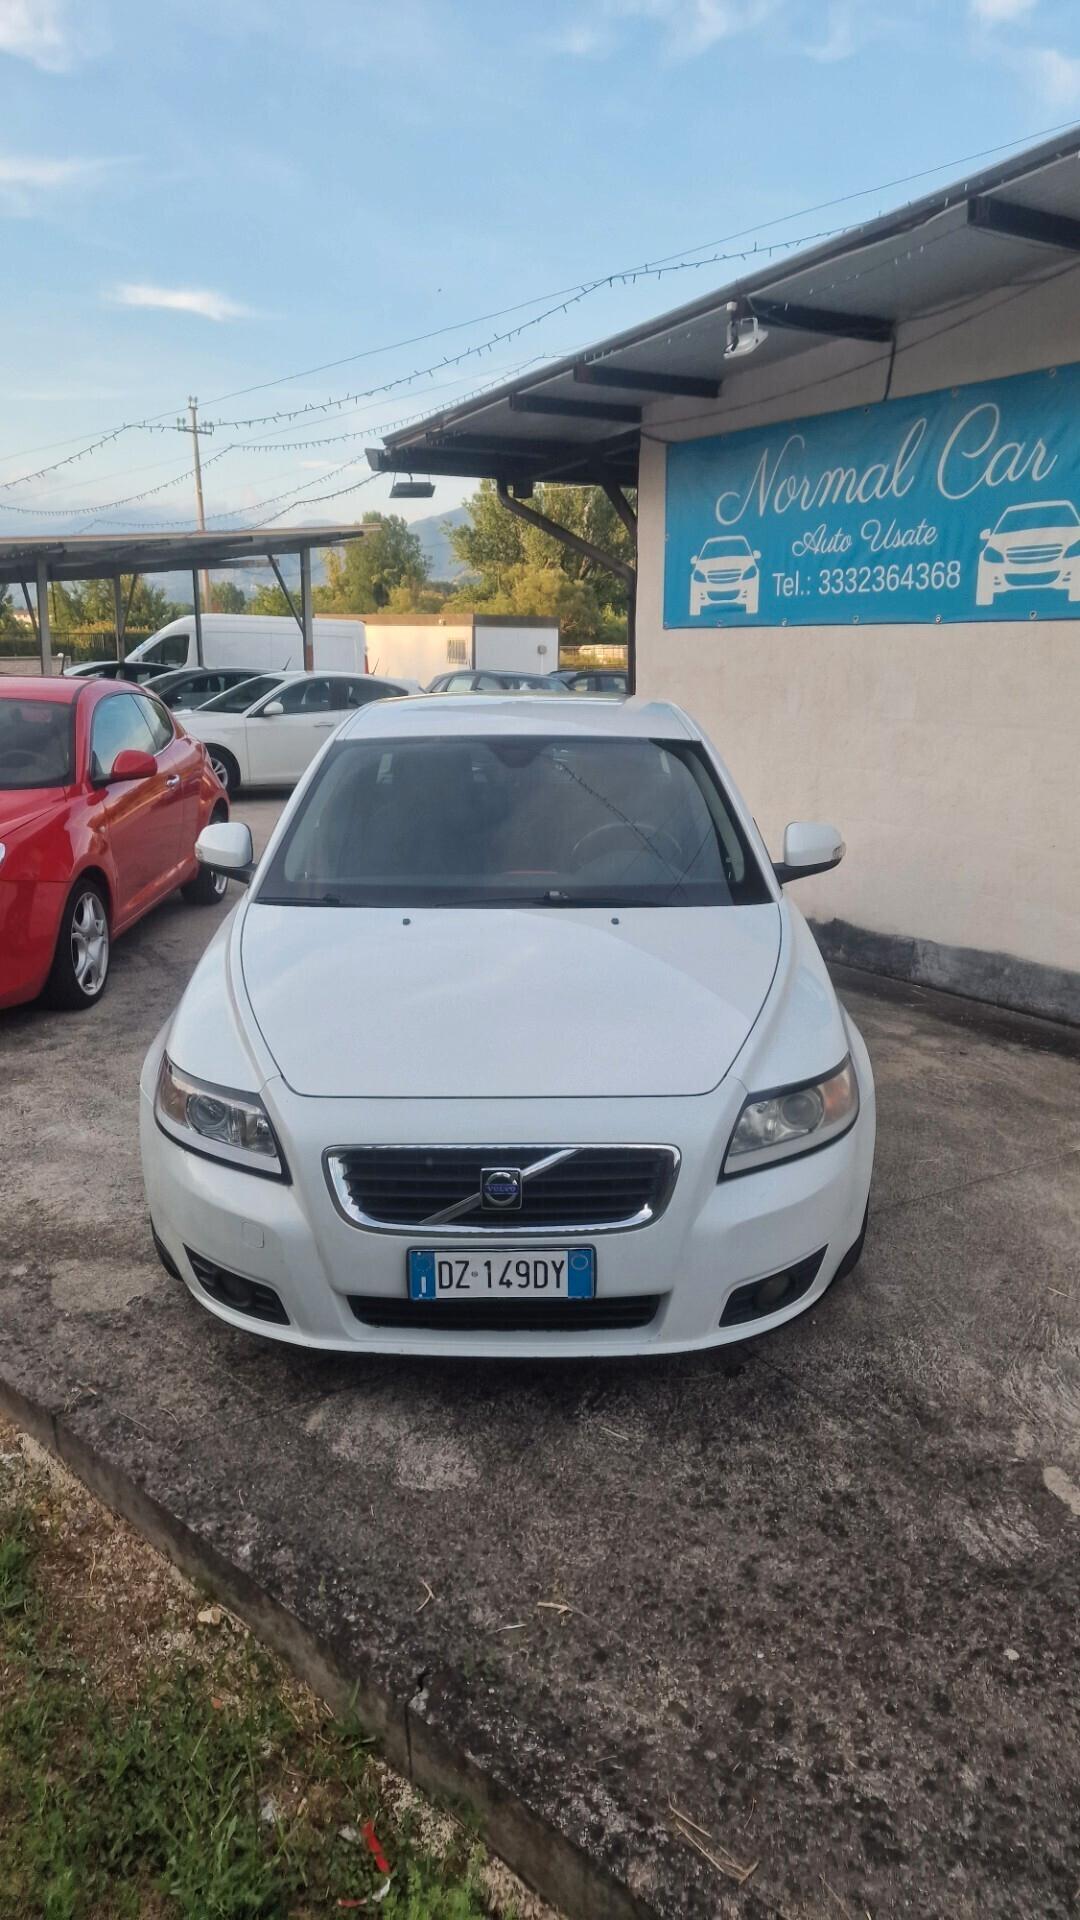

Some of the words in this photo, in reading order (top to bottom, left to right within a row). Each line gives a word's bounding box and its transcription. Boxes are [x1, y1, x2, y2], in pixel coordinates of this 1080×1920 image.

[715, 418, 927, 525] Normal
[936, 403, 1058, 500] Car
[792, 523, 852, 557] Auto
[861, 518, 938, 552] Usate
[772, 572, 811, 597] Tel.:
[818, 561, 961, 595] 3332364368
[486, 1185, 517, 1193] VOLVO
